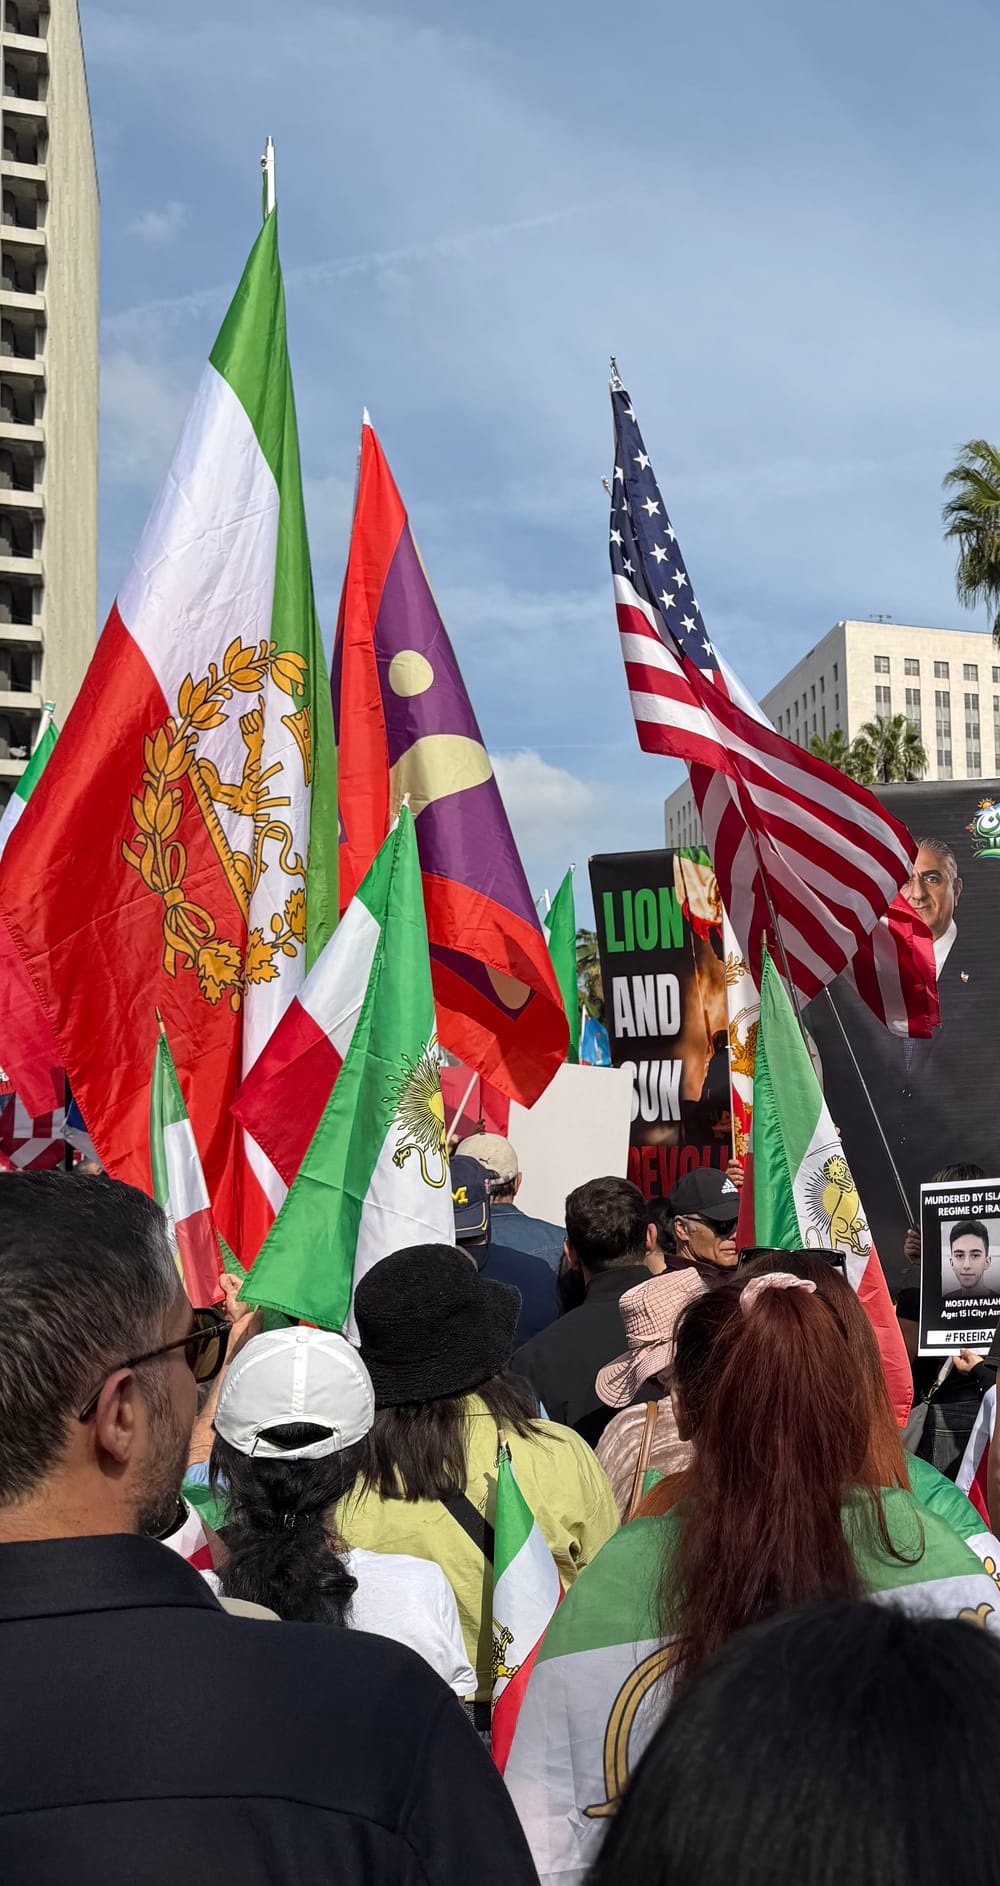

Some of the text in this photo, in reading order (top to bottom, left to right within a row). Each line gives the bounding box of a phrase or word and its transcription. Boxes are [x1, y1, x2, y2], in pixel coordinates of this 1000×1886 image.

[603, 886, 684, 953] LION
[612, 973, 681, 1038] AND
[924, 1194, 971, 1205] MURDERED
[972, 1193, 984, 1202] BY
[938, 1206, 970, 1216] REGIME
[971, 1205, 984, 1214] OF
[945, 1299, 978, 1308] MOSTAFA
[941, 1310, 958, 1319] Age:
[959, 1309, 967, 1317] 15
[971, 1308, 987, 1319] City:
[945, 1330, 994, 1343] #FREEIRA
